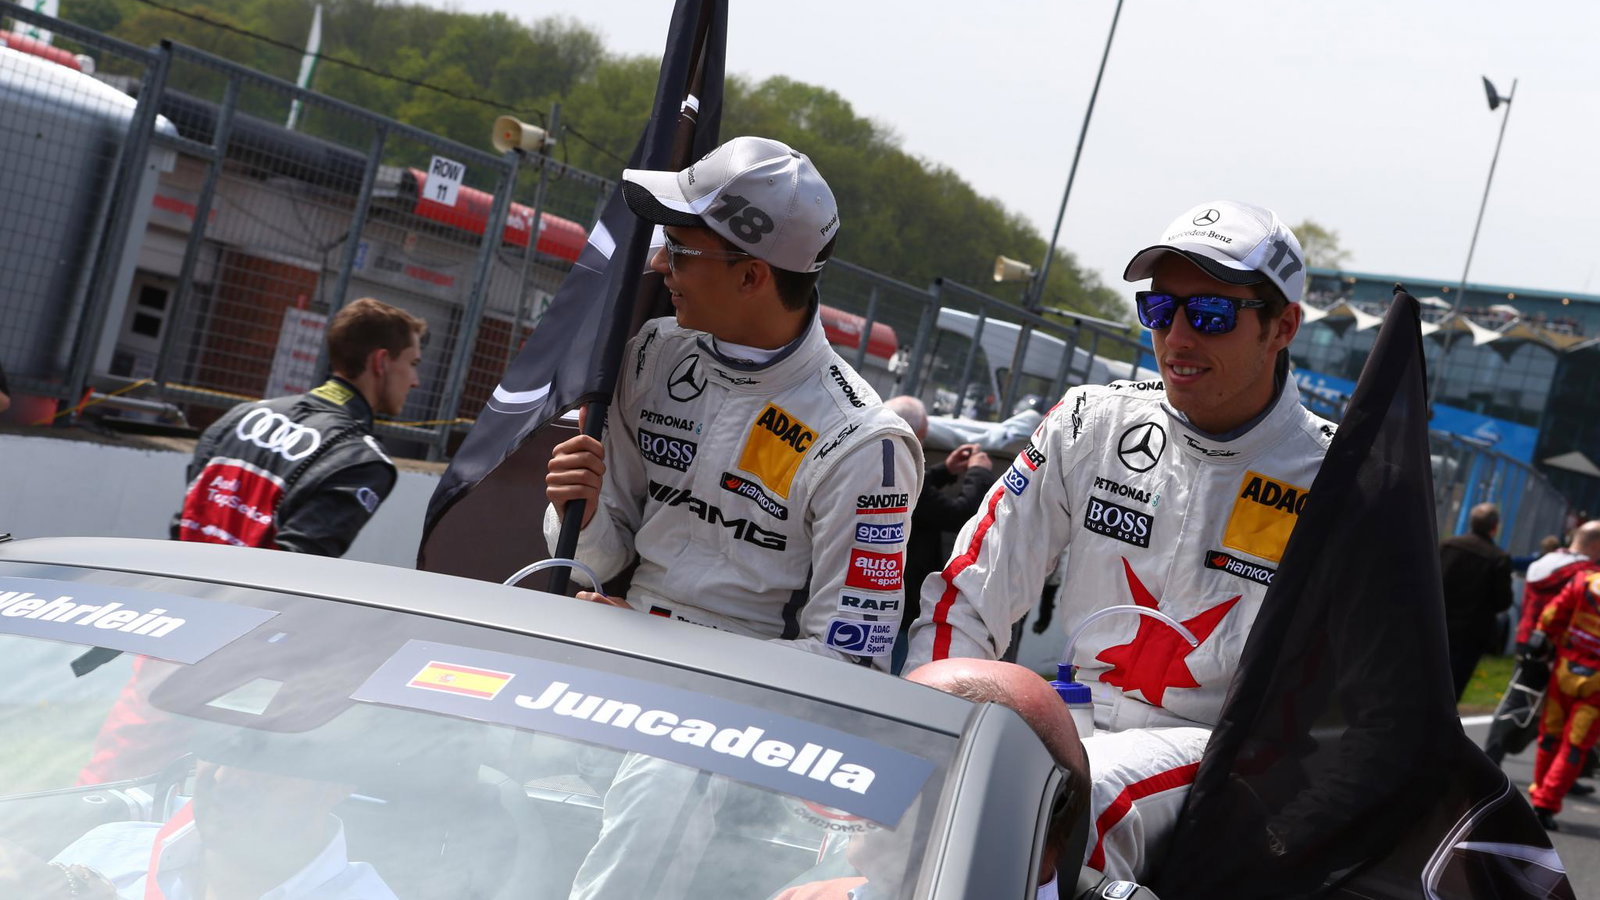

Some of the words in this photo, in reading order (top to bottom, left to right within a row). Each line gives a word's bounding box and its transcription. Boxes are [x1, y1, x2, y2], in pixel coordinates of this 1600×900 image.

[432, 159, 461, 181] ROW
[437, 184, 448, 200] 11
[711, 194, 774, 244] 18
[1267, 240, 1302, 283] 17
[829, 364, 866, 408] PETRONAS
[640, 409, 695, 431] PETRONAS
[756, 407, 813, 453] ADAC
[640, 433, 693, 464] BOSS
[209, 475, 240, 492] Audi
[1093, 476, 1151, 504] PETRONAS
[737, 482, 783, 518] Hankook
[856, 493, 908, 509] SANDTLER
[1088, 501, 1148, 537] BOSS
[1086, 521, 1111, 533] HUGO
[1117, 531, 1145, 545] BOSS
[855, 556, 896, 570] auto
[863, 568, 900, 578] motor
[877, 577, 901, 587] sport
[841, 595, 899, 611] RAFI
[869, 634, 894, 645] Stiftung
[872, 624, 891, 633] ADAC
[867, 644, 885, 654] Sport
[514, 681, 876, 795] Juncadella
